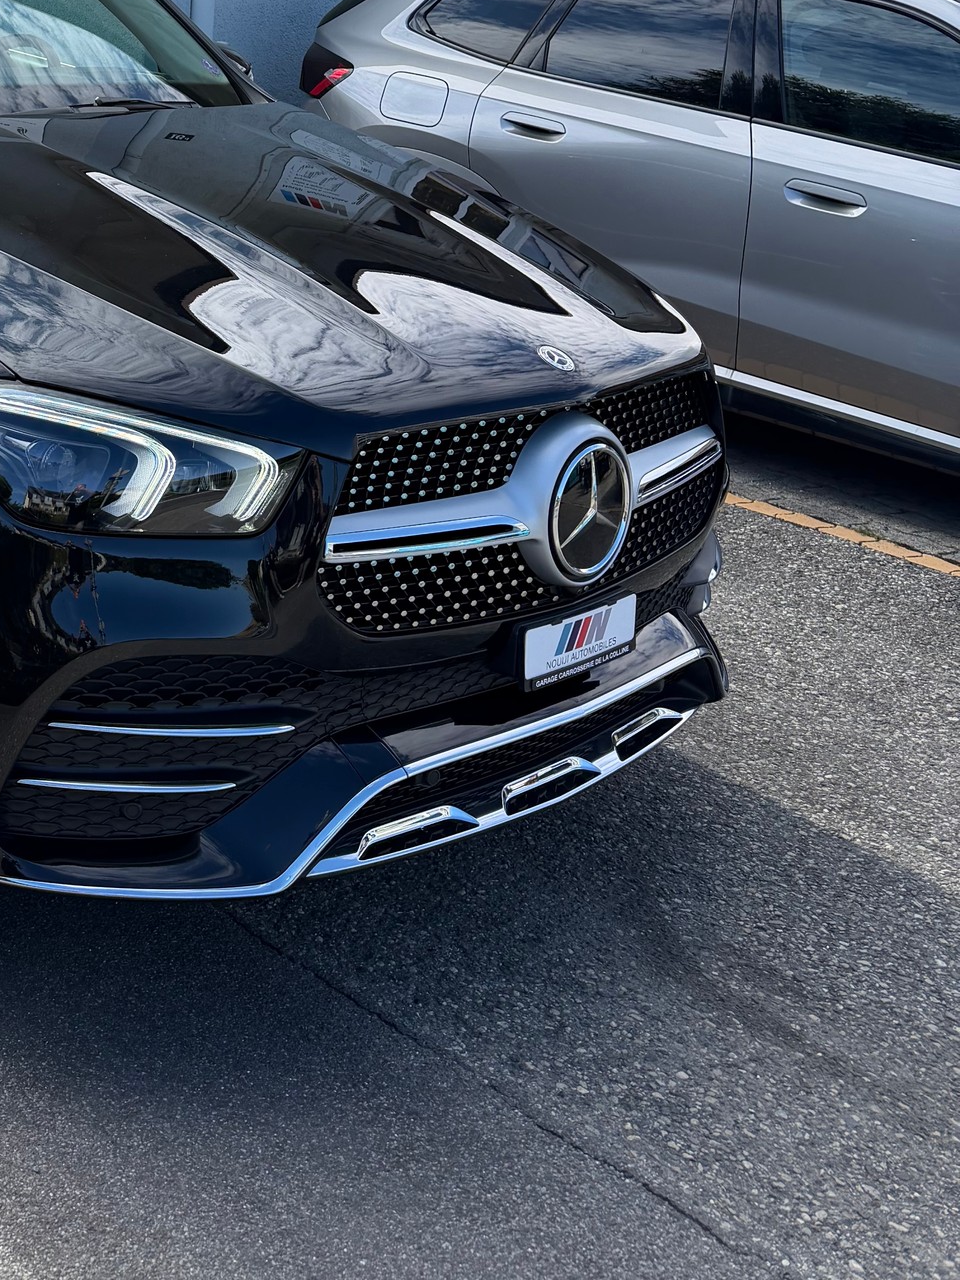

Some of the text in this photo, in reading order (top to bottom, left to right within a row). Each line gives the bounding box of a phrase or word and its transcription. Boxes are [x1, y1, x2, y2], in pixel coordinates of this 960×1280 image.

[536, 675, 558, 687] GARAGE
[559, 660, 594, 679] CARROSSERIE
[603, 655, 609, 663] LA
[609, 645, 630, 660] COLLINE
[546, 637, 617, 670] NOUIJI AUTOMOBILES
